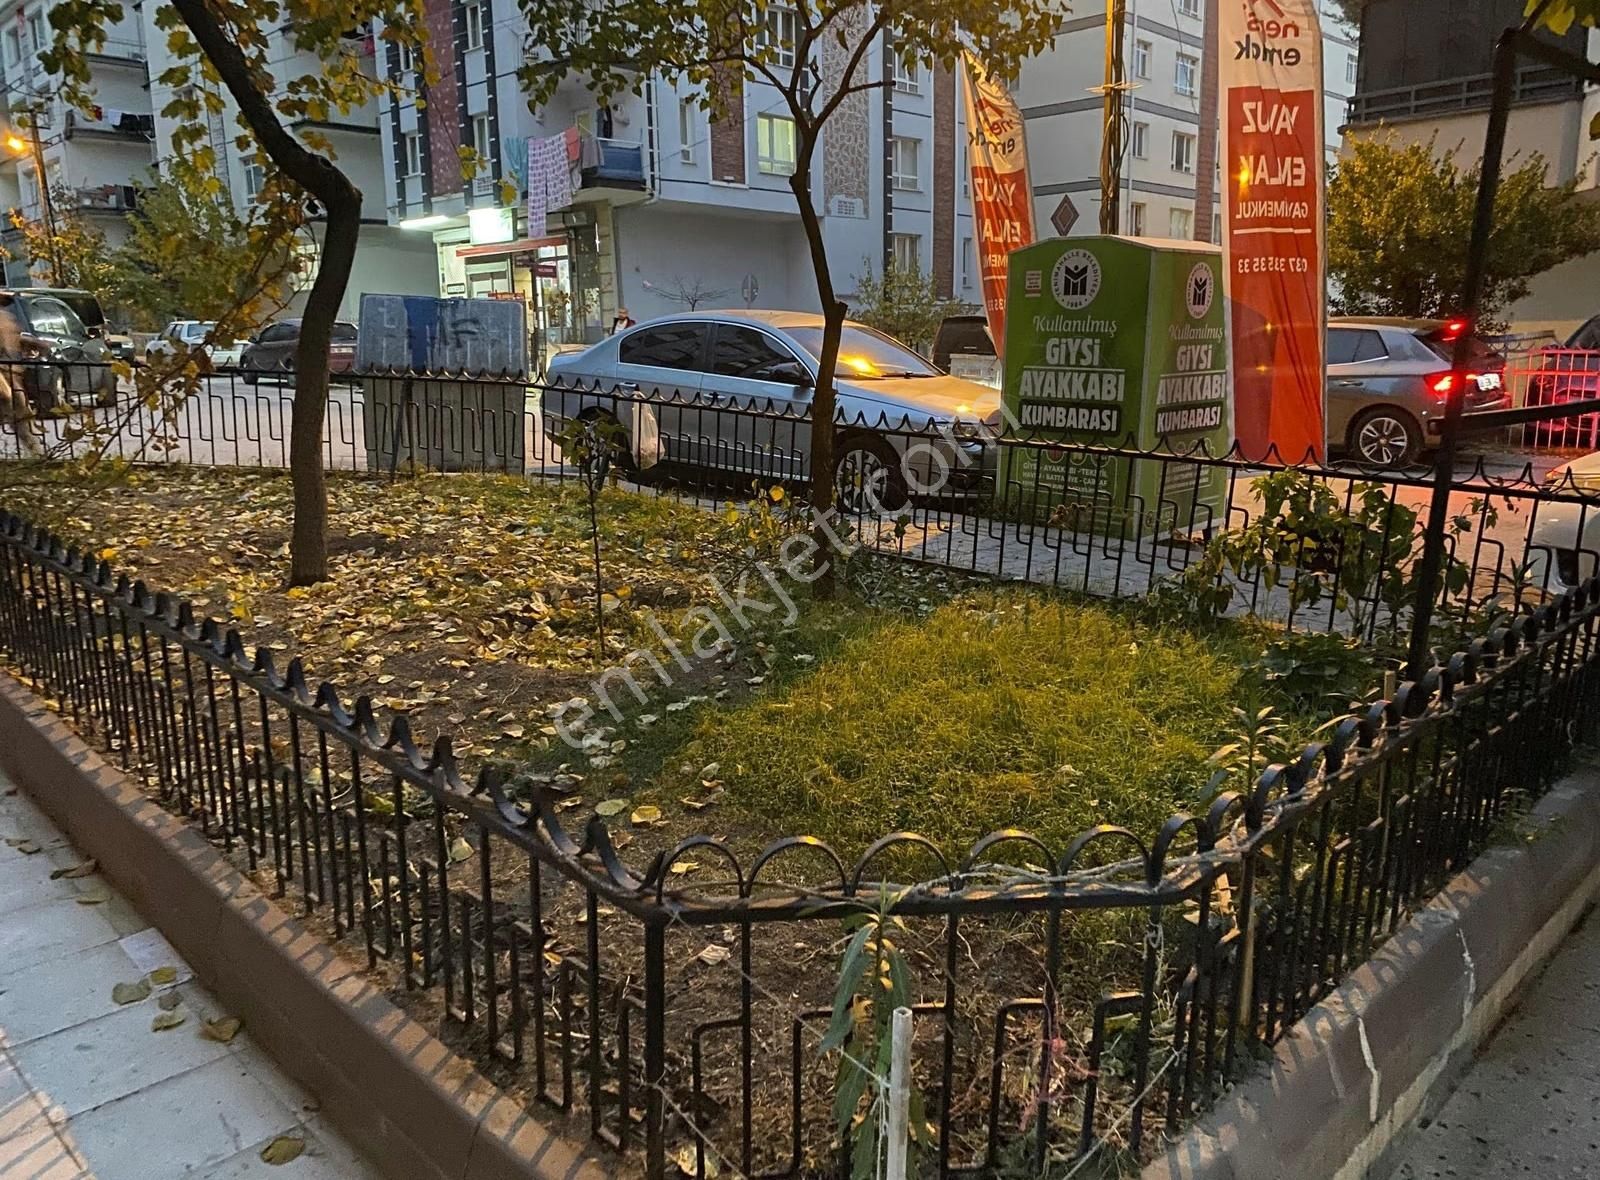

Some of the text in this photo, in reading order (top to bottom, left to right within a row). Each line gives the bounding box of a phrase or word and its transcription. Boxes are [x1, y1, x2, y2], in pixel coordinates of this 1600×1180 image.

[1032, 314, 1117, 338] Kullanılmış
[1168, 323, 1223, 343] Kullanılmış
[1019, 370, 1126, 402] AYAKKABI
[1156, 373, 1226, 405] AYAKKABI
[1021, 404, 1119, 432] KUMBARASI
[1157, 406, 1221, 433] KUMBARASI
